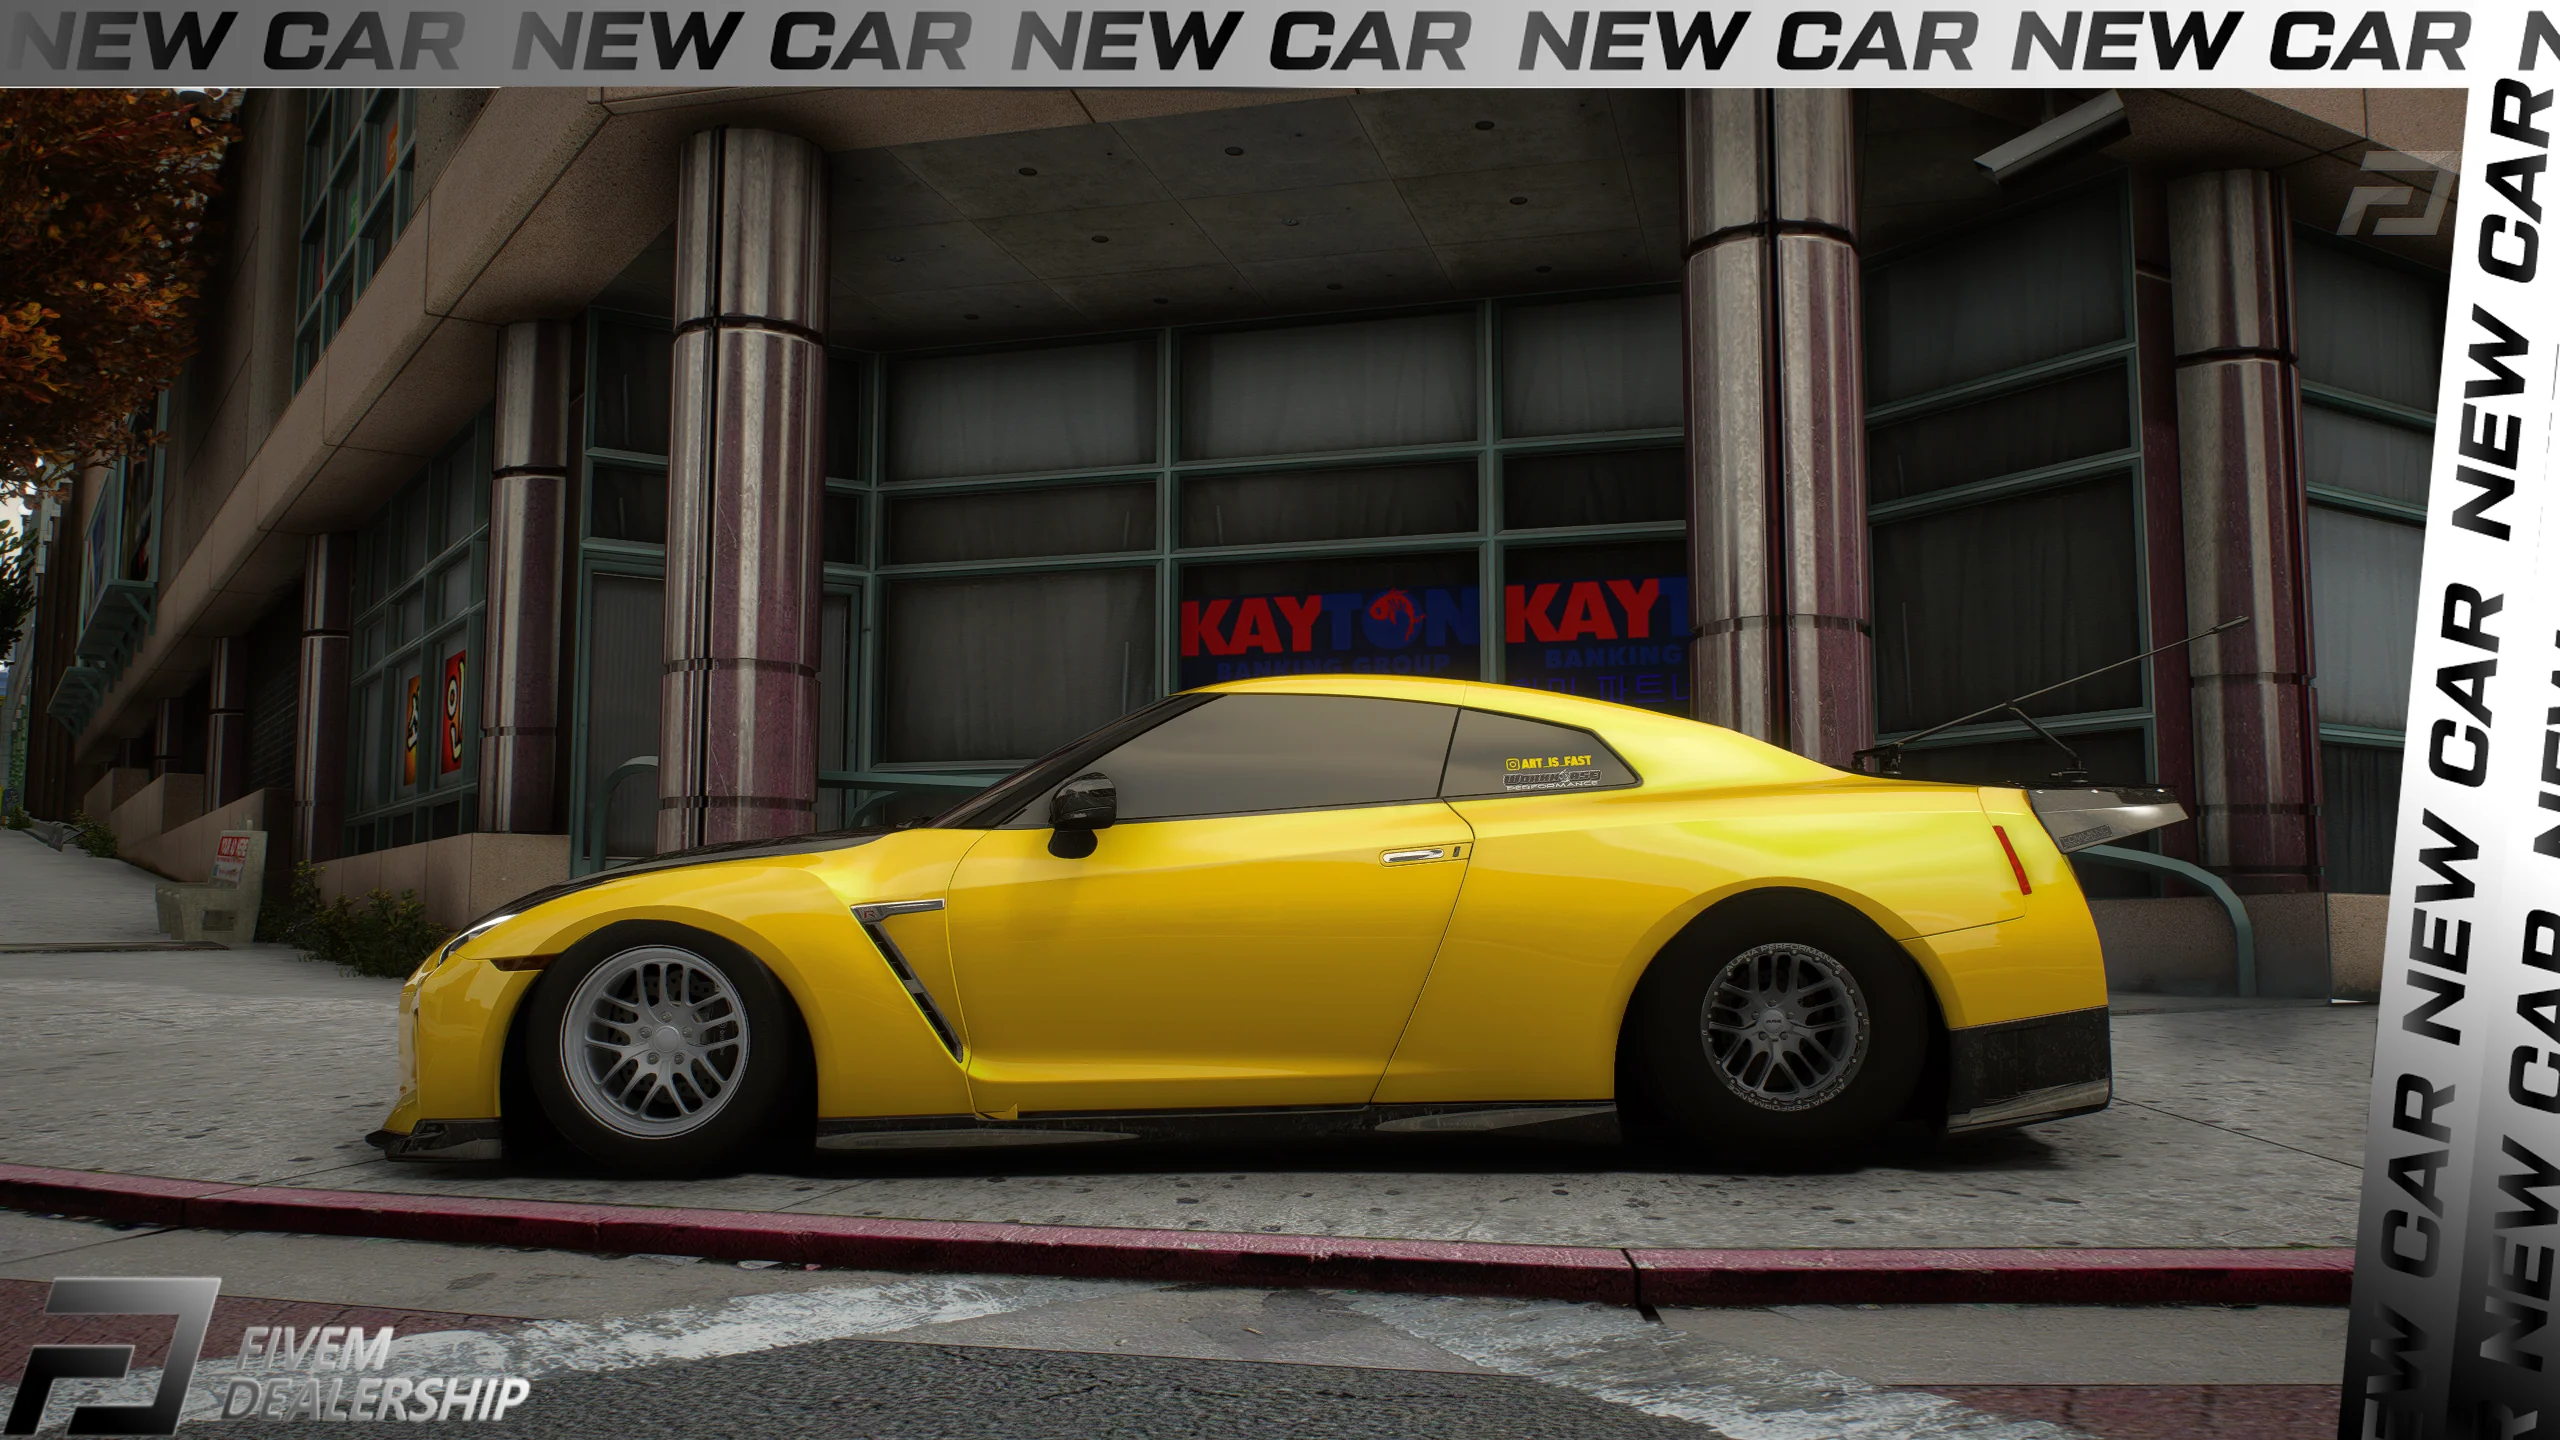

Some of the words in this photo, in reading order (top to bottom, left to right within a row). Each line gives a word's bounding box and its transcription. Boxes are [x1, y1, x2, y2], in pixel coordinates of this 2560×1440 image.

[1181, 587, 1479, 656] KAYTON
[1351, 652, 1452, 675] GROUP
[1545, 643, 1684, 668] BANKING
[1521, 754, 1592, 770] ART_IS_FAST
[1725, 948, 1760, 972] ALPHA
[1760, 943, 1846, 973] PERFORMANCE
